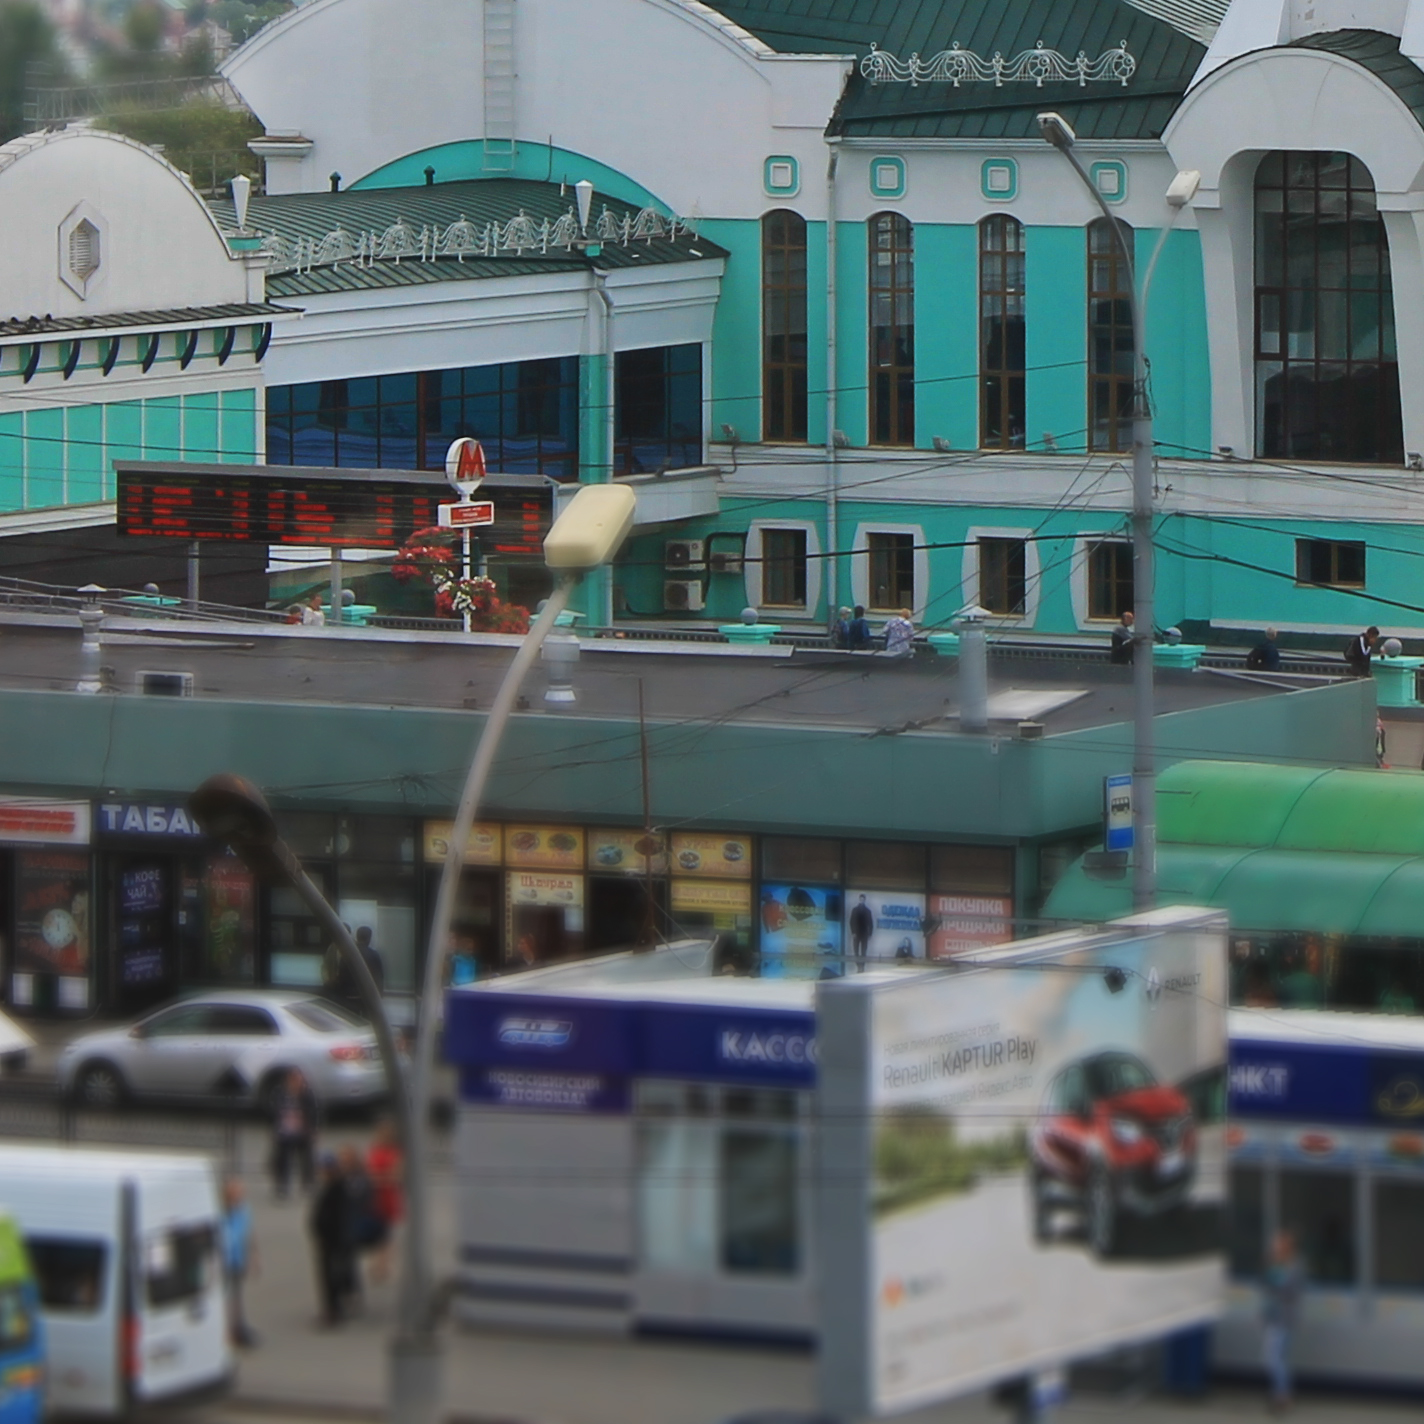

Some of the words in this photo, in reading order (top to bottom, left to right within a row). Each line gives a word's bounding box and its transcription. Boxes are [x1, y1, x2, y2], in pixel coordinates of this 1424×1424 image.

[135, 869, 161, 883] КОФЕ
[127, 886, 148, 900] ЧАЙ
[939, 897, 1005, 915] ПОКУПКА
[883, 1054, 939, 1090] Renault
[941, 1040, 1004, 1078] KAPTUR
[1006, 1035, 1037, 1066] Play
[488, 1071, 601, 1091] НОВОСИБИРСКИЙ
[500, 1087, 587, 1105] АВТОВОКЗАЛ
